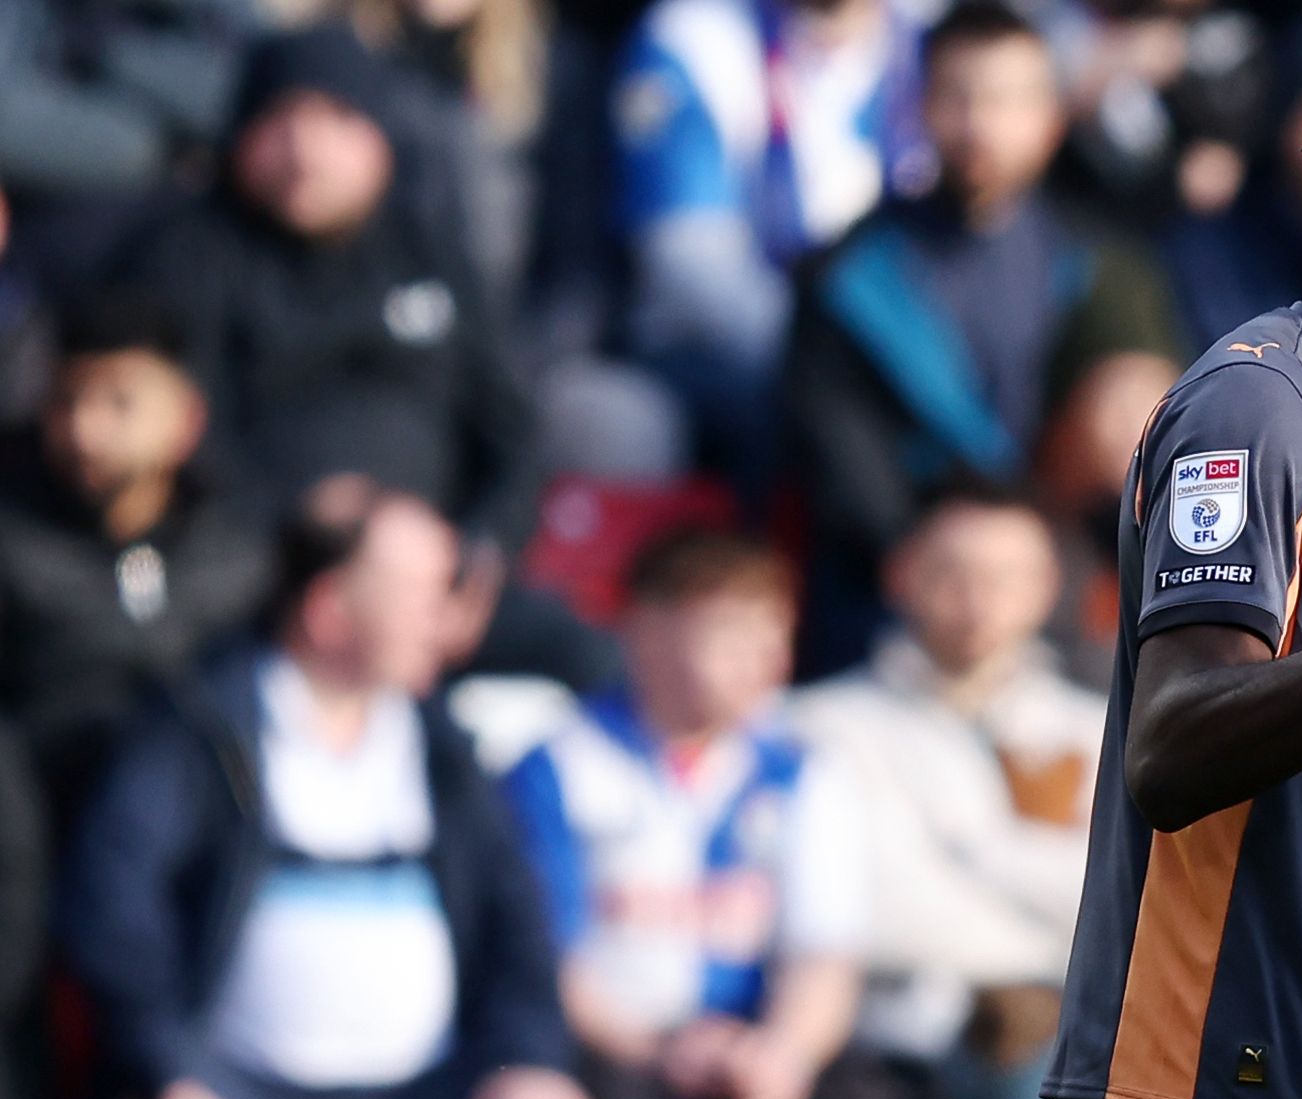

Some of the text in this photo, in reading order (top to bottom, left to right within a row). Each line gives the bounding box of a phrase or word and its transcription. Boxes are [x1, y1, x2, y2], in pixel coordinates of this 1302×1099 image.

[1178, 462, 1237, 481] sky bet
[1177, 482, 1240, 496] CHAMPIONSHIP
[1194, 530, 1217, 543] EFL
